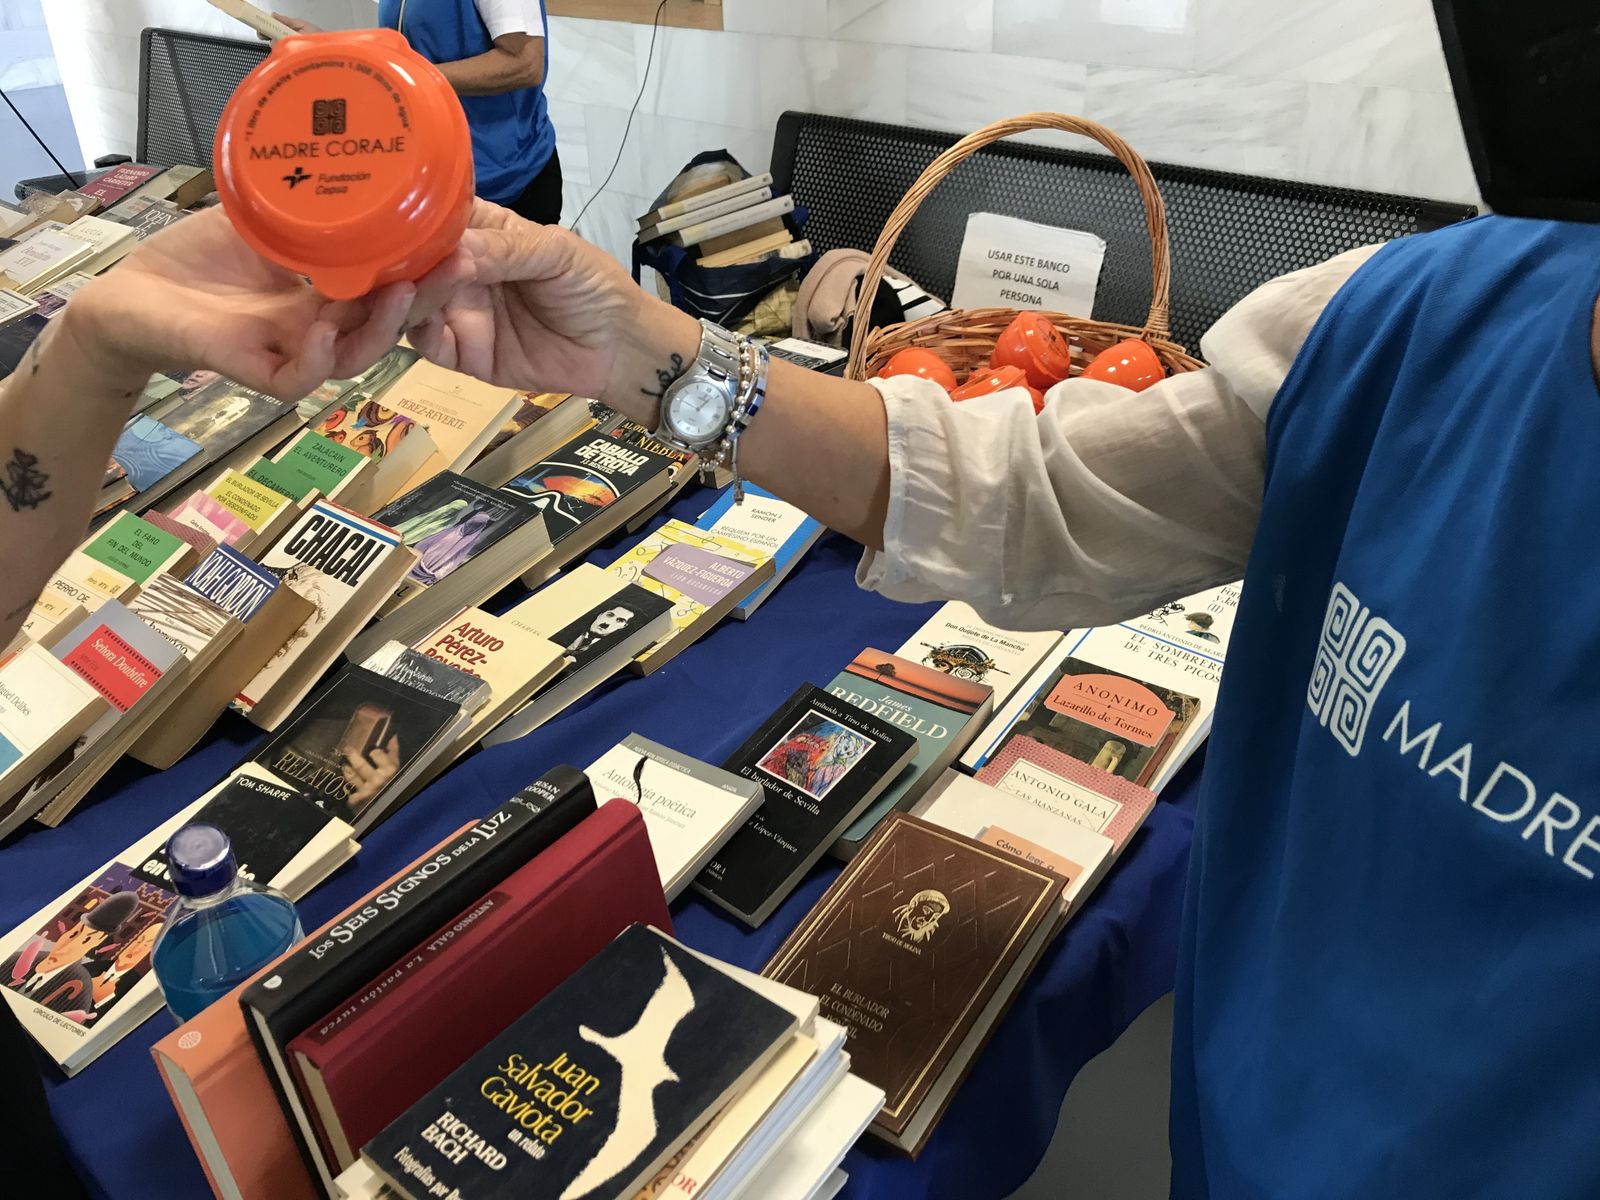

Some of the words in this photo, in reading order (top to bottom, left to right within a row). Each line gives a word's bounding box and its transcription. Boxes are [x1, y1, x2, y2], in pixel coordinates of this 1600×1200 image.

[250, 142, 320, 160] MADRE
[325, 136, 406, 157] CORAJE
[315, 185, 348, 195] Cepsa
[318, 172, 371, 183] Fundación
[143, 209, 178, 226] JOHN
[987, 249, 1013, 262] USAR
[1014, 254, 1035, 267] ESTE
[1037, 259, 1071, 274] BANCO
[992, 269, 1012, 281] POR
[1013, 273, 1034, 286] UNA
[1036, 277, 1060, 291] SOLA
[1000, 288, 1043, 307] PERSONA
[293, 446, 302, 455] EL
[302, 451, 347, 477] AVENTURERO
[574, 445, 597, 459] DE
[593, 452, 640, 477] TROYA
[589, 438, 650, 466] CABALLO
[248, 469, 257, 479] EL
[225, 490, 233, 498] EL
[233, 494, 261, 513] CONDENADO
[231, 479, 255, 496] BURLADOR
[261, 495, 280, 509] SEVILLA
[750, 514, 776, 523] SENDER
[131, 540, 143, 550] DEL
[133, 528, 142, 536] EL
[142, 531, 160, 545] FARO
[711, 529, 749, 542] CAMPESINO
[106, 539, 118, 549] FIN
[117, 544, 128, 555] DEL
[128, 550, 152, 567] MUNDO
[284, 514, 386, 587] CHACAL
[709, 562, 745, 579] ALBERTO
[53, 579, 77, 597] PERRO
[76, 592, 91, 603] DE
[98, 581, 108, 590] RTV
[183, 551, 235, 595] NOAH
[209, 568, 272, 622] GORDON
[44, 602, 55, 611] RTV
[451, 622, 505, 653] Arturo
[945, 622, 958, 630] Don
[958, 626, 981, 637] Quijote
[999, 639, 1025, 652] Mancha
[1130, 633, 1146, 645] EL
[1139, 624, 1161, 635] PEDRO
[1161, 631, 1193, 647] ANTONIO
[91, 638, 117, 662] Señora
[437, 634, 488, 665] Pérez-
[1123, 641, 1142, 653] DE
[1147, 650, 1179, 667] TRES
[1184, 664, 1221, 684] PICOS
[113, 656, 148, 688] Doubtfire
[10, 695, 31, 716] Delibes
[830, 686, 948, 740] REDFIELD
[879, 695, 913, 712] James
[844, 713, 860, 727] Tirso
[860, 722, 870, 731] de
[869, 727, 893, 743] Molina
[1050, 694, 1098, 720] Lazarillo
[1098, 709, 1112, 723] de
[1113, 713, 1155, 740] Tormes
[272, 750, 356, 801] RELATOS
[533, 780, 560, 795] SUSAN
[235, 777, 257, 792] TOM
[255, 782, 291, 801] SHARPE
[524, 785, 556, 802] COOPER
[740, 766, 752, 776] El
[751, 771, 783, 794] burlador
[783, 789, 794, 800] de
[793, 795, 821, 816] Sevilla
[1011, 769, 1071, 801] ANTONIO
[1074, 798, 1107, 820] GALA
[1382, 700, 1600, 880] MADRE
[653, 795, 697, 819] poética
[1015, 789, 1033, 801] LAS
[1032, 797, 1083, 825] MANZANAS
[471, 810, 512, 841] LUZ
[996, 839, 1022, 856] Cómo
[142, 859, 168, 877] en
[453, 899, 495, 932] ANTONIO
[427, 931, 455, 952] GALA
[406, 955, 424, 969] La
[360, 969, 403, 1004] pasión
[820, 994, 831, 1007] EL
[831, 1000, 883, 1032] CONDENADO
[830, 982, 843, 995] EL
[842, 988, 890, 1019] BURLADOR
[53, 1017, 61, 1025] DE
[60, 1021, 86, 1037] LECTORES
[320, 1005, 357, 1035] turca
[544, 1052, 600, 1096] Juan
[498, 1053, 594, 1125] Salvador
[480, 1076, 564, 1145] Gaviota
[420, 1123, 469, 1165] BACH
[436, 1111, 507, 1171] RICHARD
[507, 1128, 523, 1143] un
[519, 1138, 546, 1160] relato
[428, 1180, 450, 1197] por
